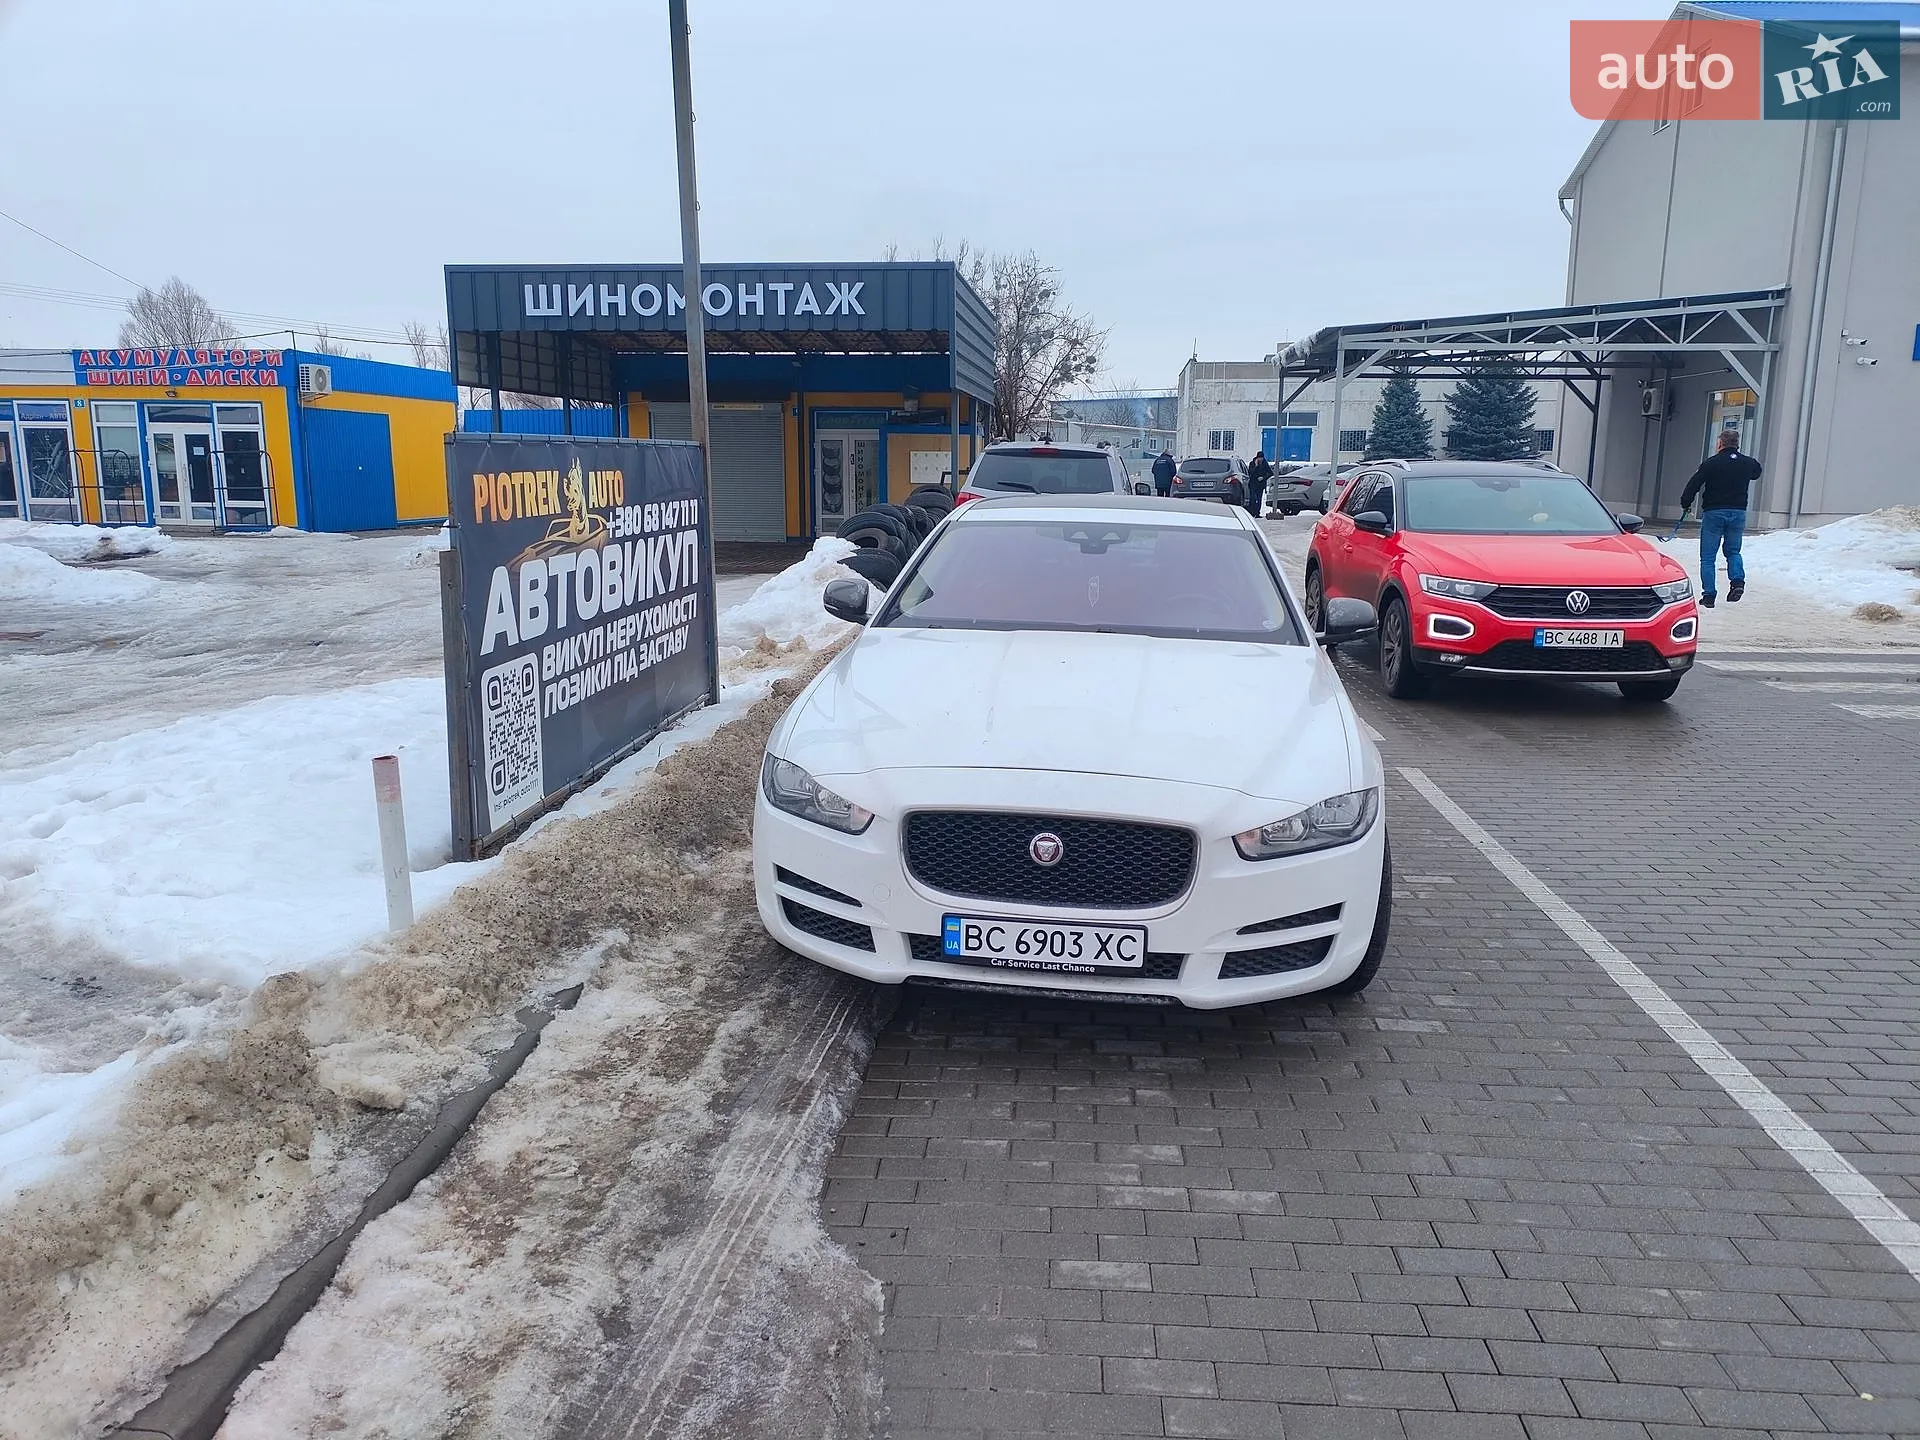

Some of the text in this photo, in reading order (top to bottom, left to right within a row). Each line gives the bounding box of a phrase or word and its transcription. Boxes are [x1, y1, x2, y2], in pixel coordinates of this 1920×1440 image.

[524, 282, 866, 317] ШИНОМОНТАЖ
[79, 349, 284, 367] АКУМУЛЯТОРИ
[86, 368, 281, 386] ШИНИ ДИСКИ
[472, 470, 625, 525] PIOTREK AUTO
[606, 503, 640, 540] +380
[643, 503, 659, 533] 68
[660, 500, 680, 530] 147
[480, 529, 699, 657] АВТОВИКУП
[542, 592, 698, 682] ВИКУП НЕРУХОМОСТІ
[1544, 631, 1619, 645] BC 4488 IA
[544, 624, 690, 719] ПОЗИКИ ПІД ЗАСТАВУ
[946, 940, 959, 950] UA
[964, 924, 1138, 962] BC 6903 XC
[991, 958, 1095, 973] Car Service Last Chance
